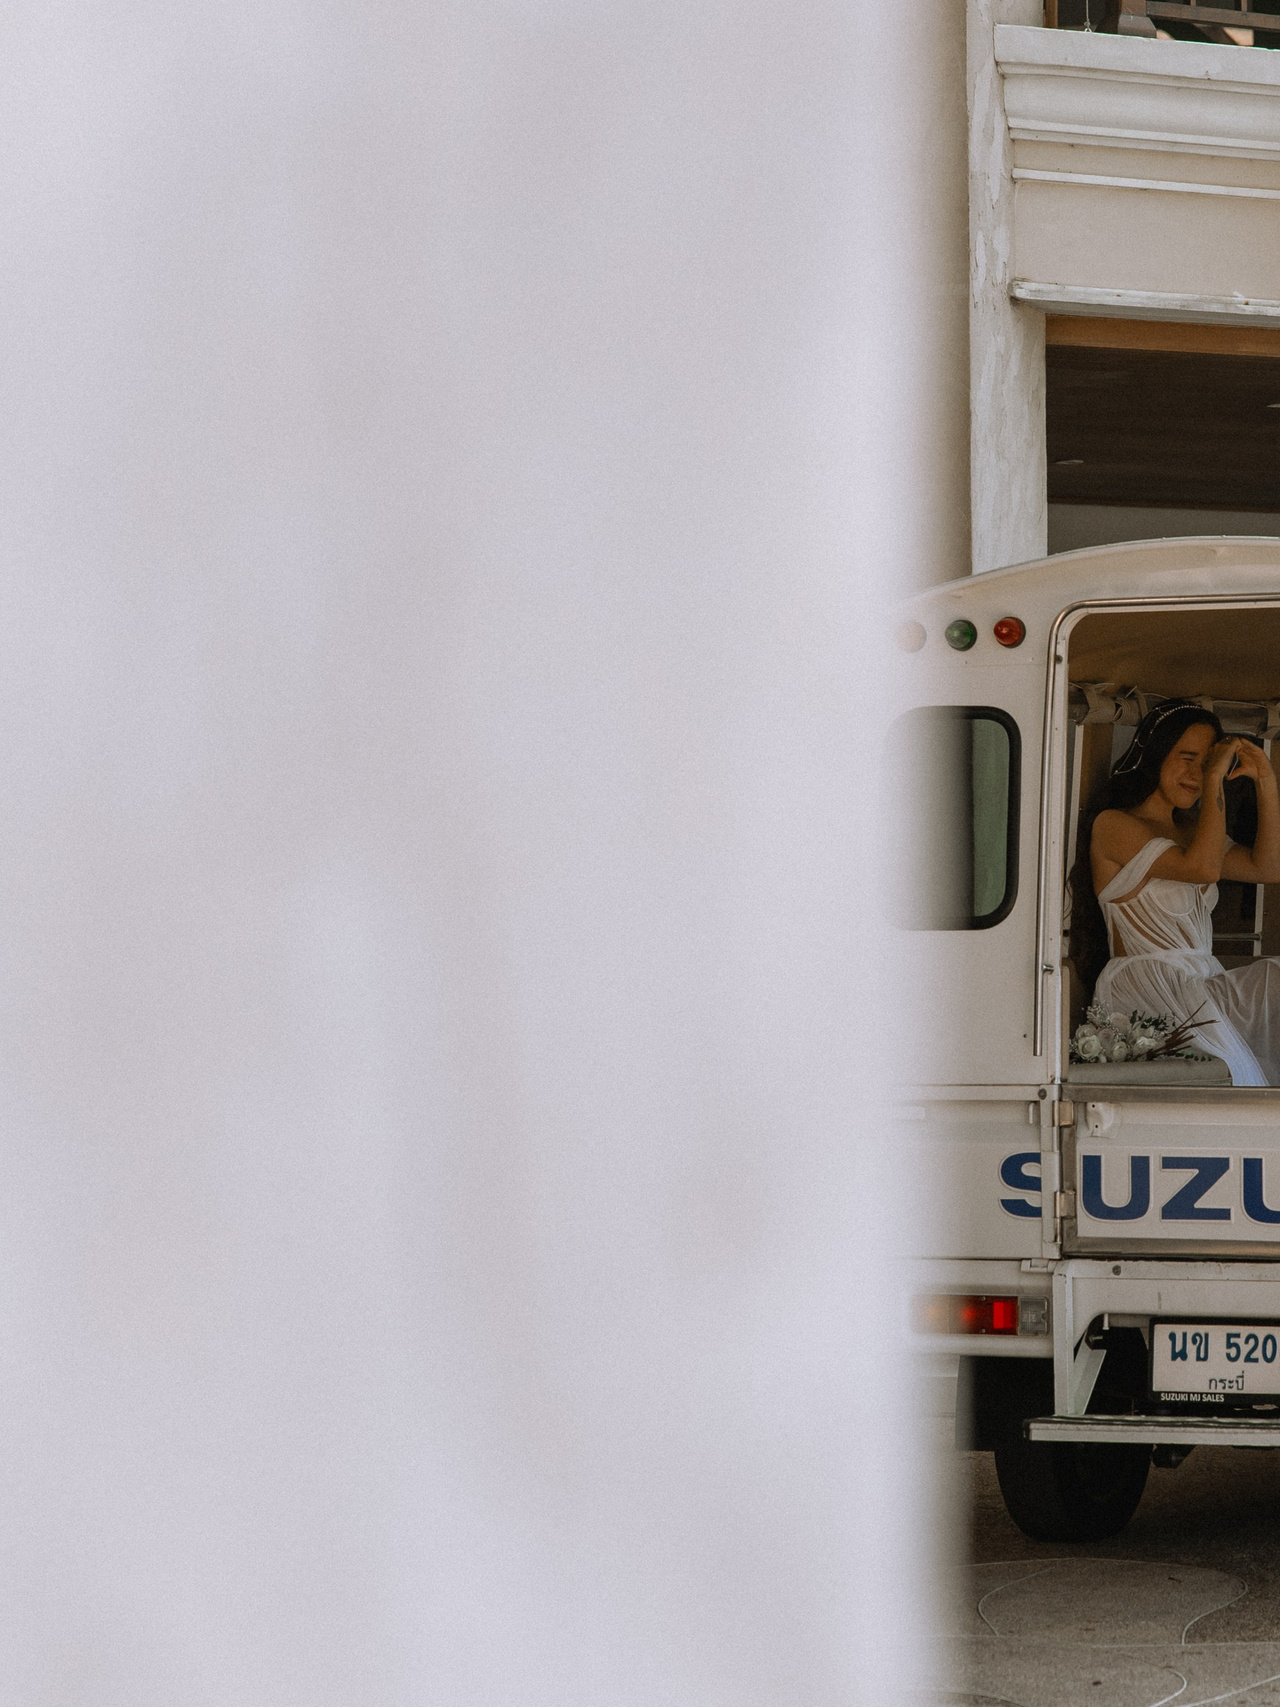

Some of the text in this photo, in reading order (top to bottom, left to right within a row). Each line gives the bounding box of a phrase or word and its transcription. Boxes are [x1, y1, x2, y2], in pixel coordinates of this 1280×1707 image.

[1208, 1370, 1245, 1391] กระบี่
[1160, 1392, 1188, 1402] SUZUKI
[1202, 1393, 1225, 1402] SALES
